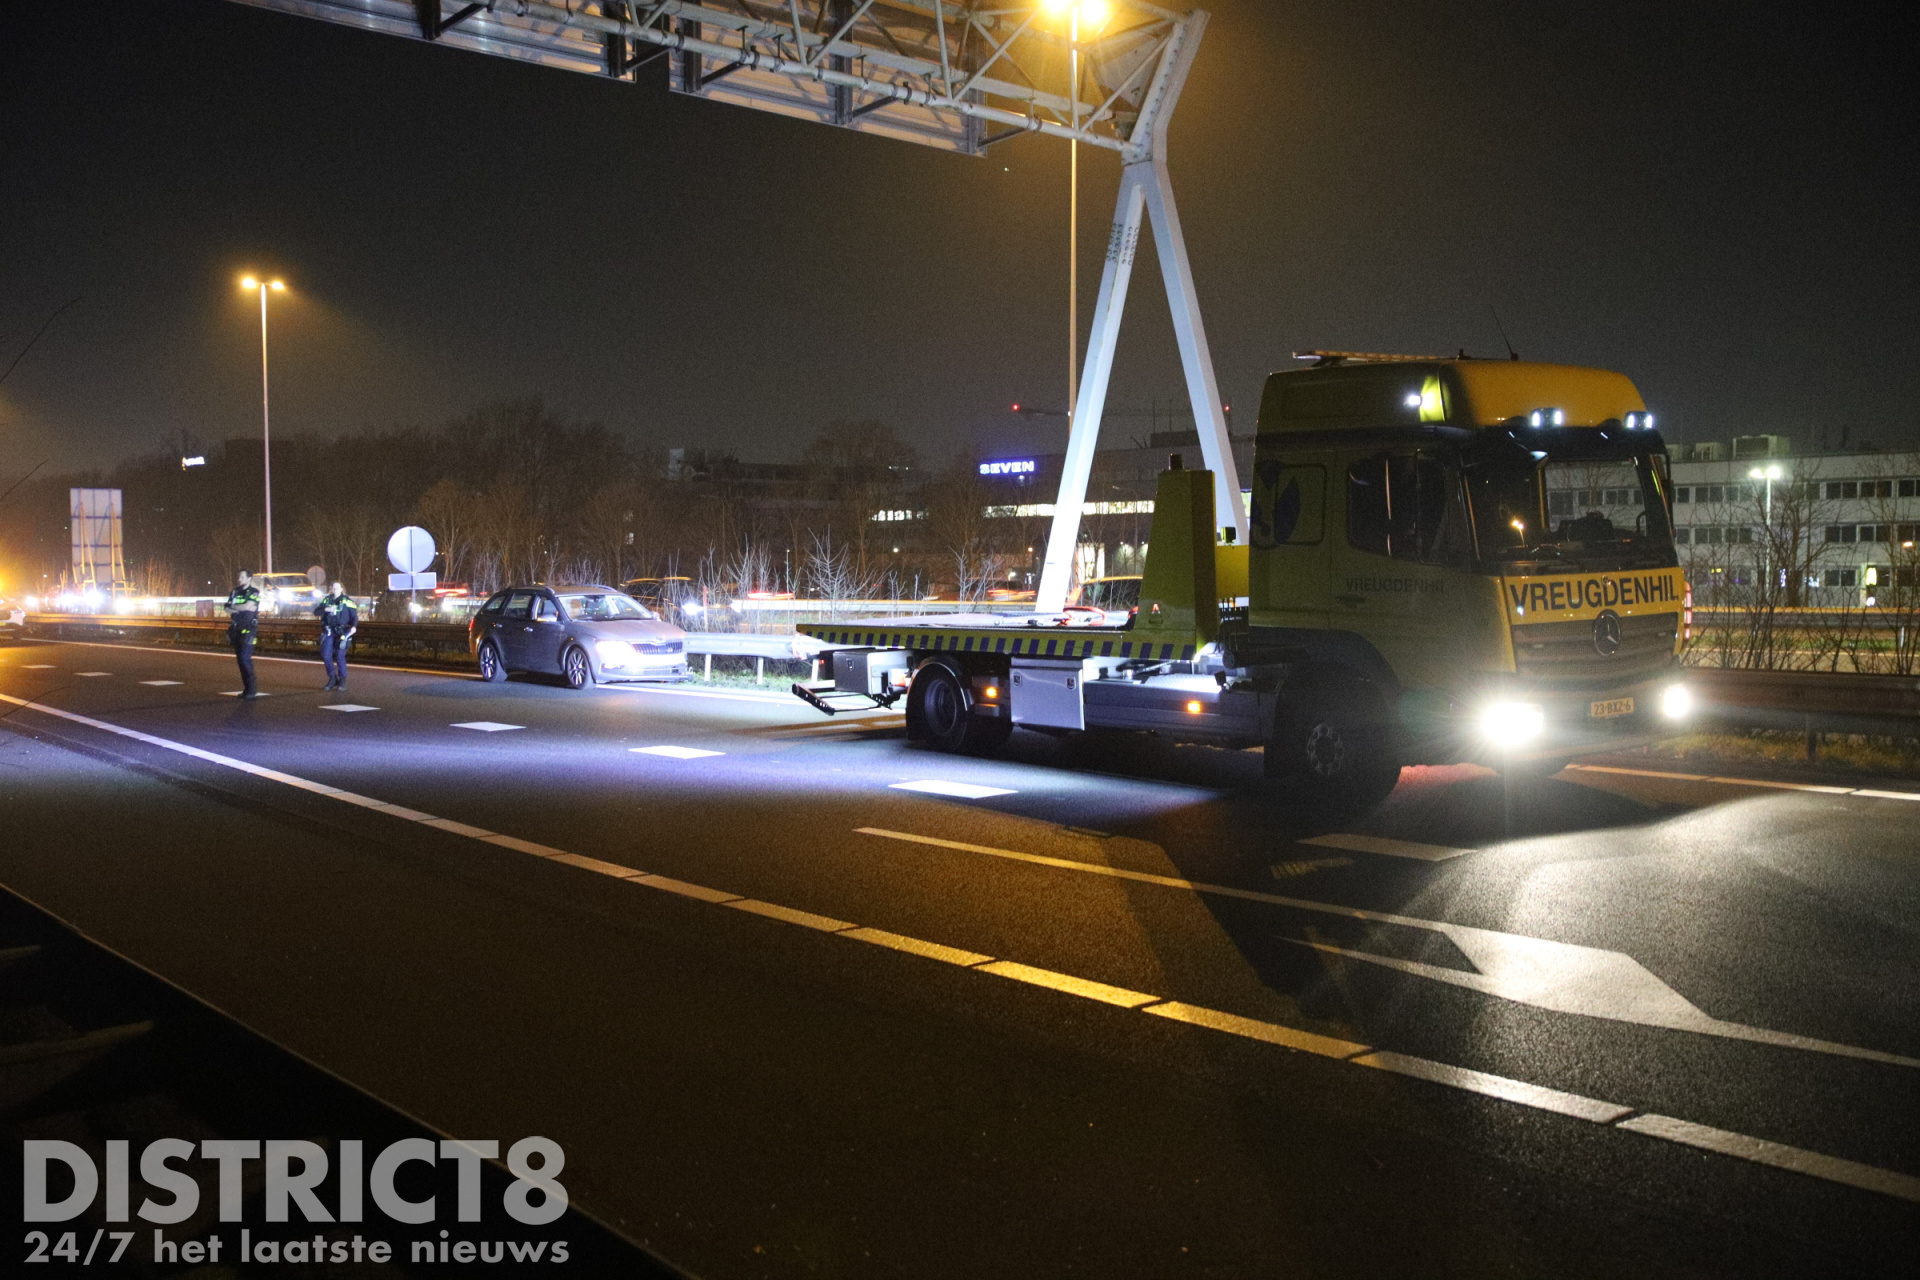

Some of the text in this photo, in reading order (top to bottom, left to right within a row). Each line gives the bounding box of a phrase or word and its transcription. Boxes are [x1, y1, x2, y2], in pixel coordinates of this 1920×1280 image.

[980, 461, 1034, 474] SEVEN
[1345, 577, 1444, 593] VREUGDENHIL
[1509, 575, 1679, 612] VREUGDENHIL
